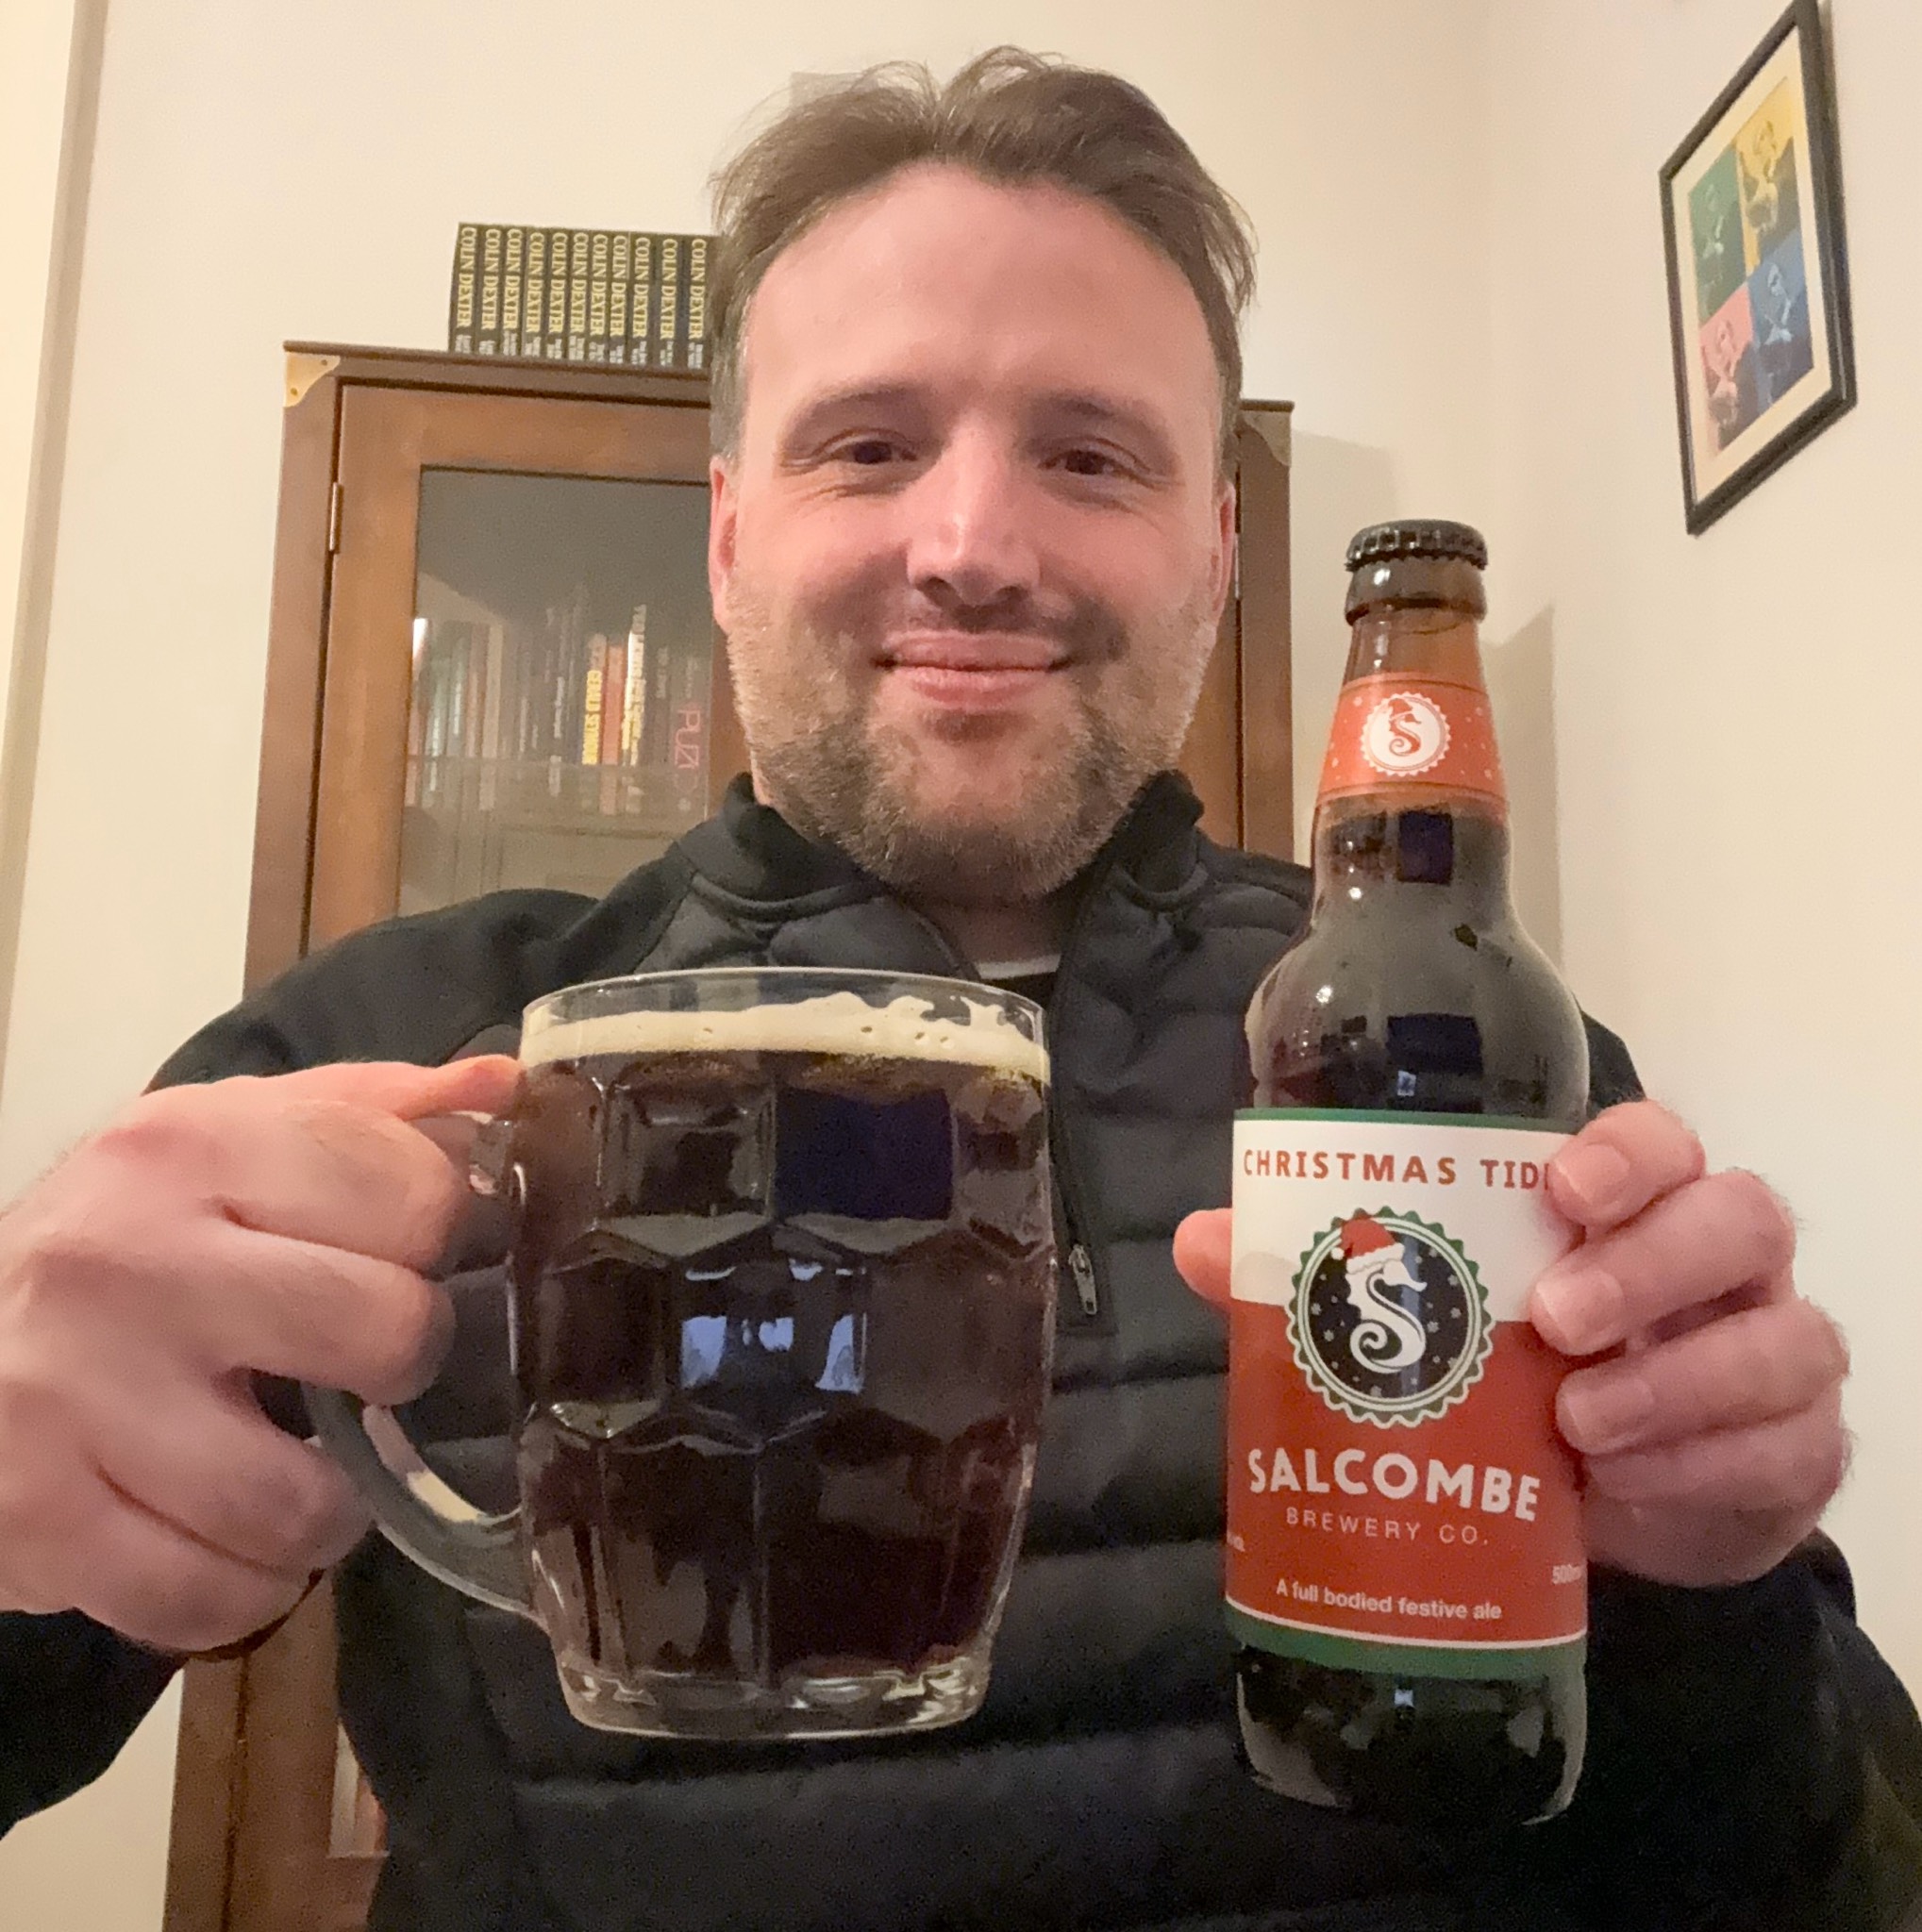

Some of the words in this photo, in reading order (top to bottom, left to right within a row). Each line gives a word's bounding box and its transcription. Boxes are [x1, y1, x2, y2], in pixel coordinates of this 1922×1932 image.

[460, 226, 477, 270] COLIN
[484, 228, 501, 272] COLIN
[506, 228, 523, 272] COLIN
[528, 232, 544, 275] COLIN
[551, 232, 568, 275] COLIN
[572, 232, 589, 275] COLIN
[592, 234, 609, 277] COLIN
[612, 235, 627, 278] COLIN
[634, 237, 651, 280] COLIN
[661, 239, 678, 282] COLIN
[690, 239, 707, 282] COLIN
[457, 273, 475, 328] DEXTER
[481, 275, 499, 330] DEXTER
[503, 275, 521, 330] DEXTER
[526, 279, 543, 333] DEXTER
[548, 279, 566, 333] DEXTER
[570, 278, 587, 333] DEXTER
[590, 281, 607, 336] DEXTER
[610, 282, 627, 337] DEXTER
[632, 284, 649, 338] DEXTER
[660, 285, 677, 340] DEXTER
[688, 285, 706, 340] DEXTER
[1243, 1148, 1458, 1185] CHRISTMAS
[1247, 1447, 1542, 1523] SALCOMBE
[1286, 1507, 1421, 1541] BREWERY
[1439, 1524, 1489, 1545] CO.
[1276, 1578, 1289, 1597] A
[1292, 1579, 1318, 1603] full
[1323, 1586, 1392, 1614] bodied
[1397, 1595, 1467, 1620] festive
[1473, 1604, 1503, 1621] ale
